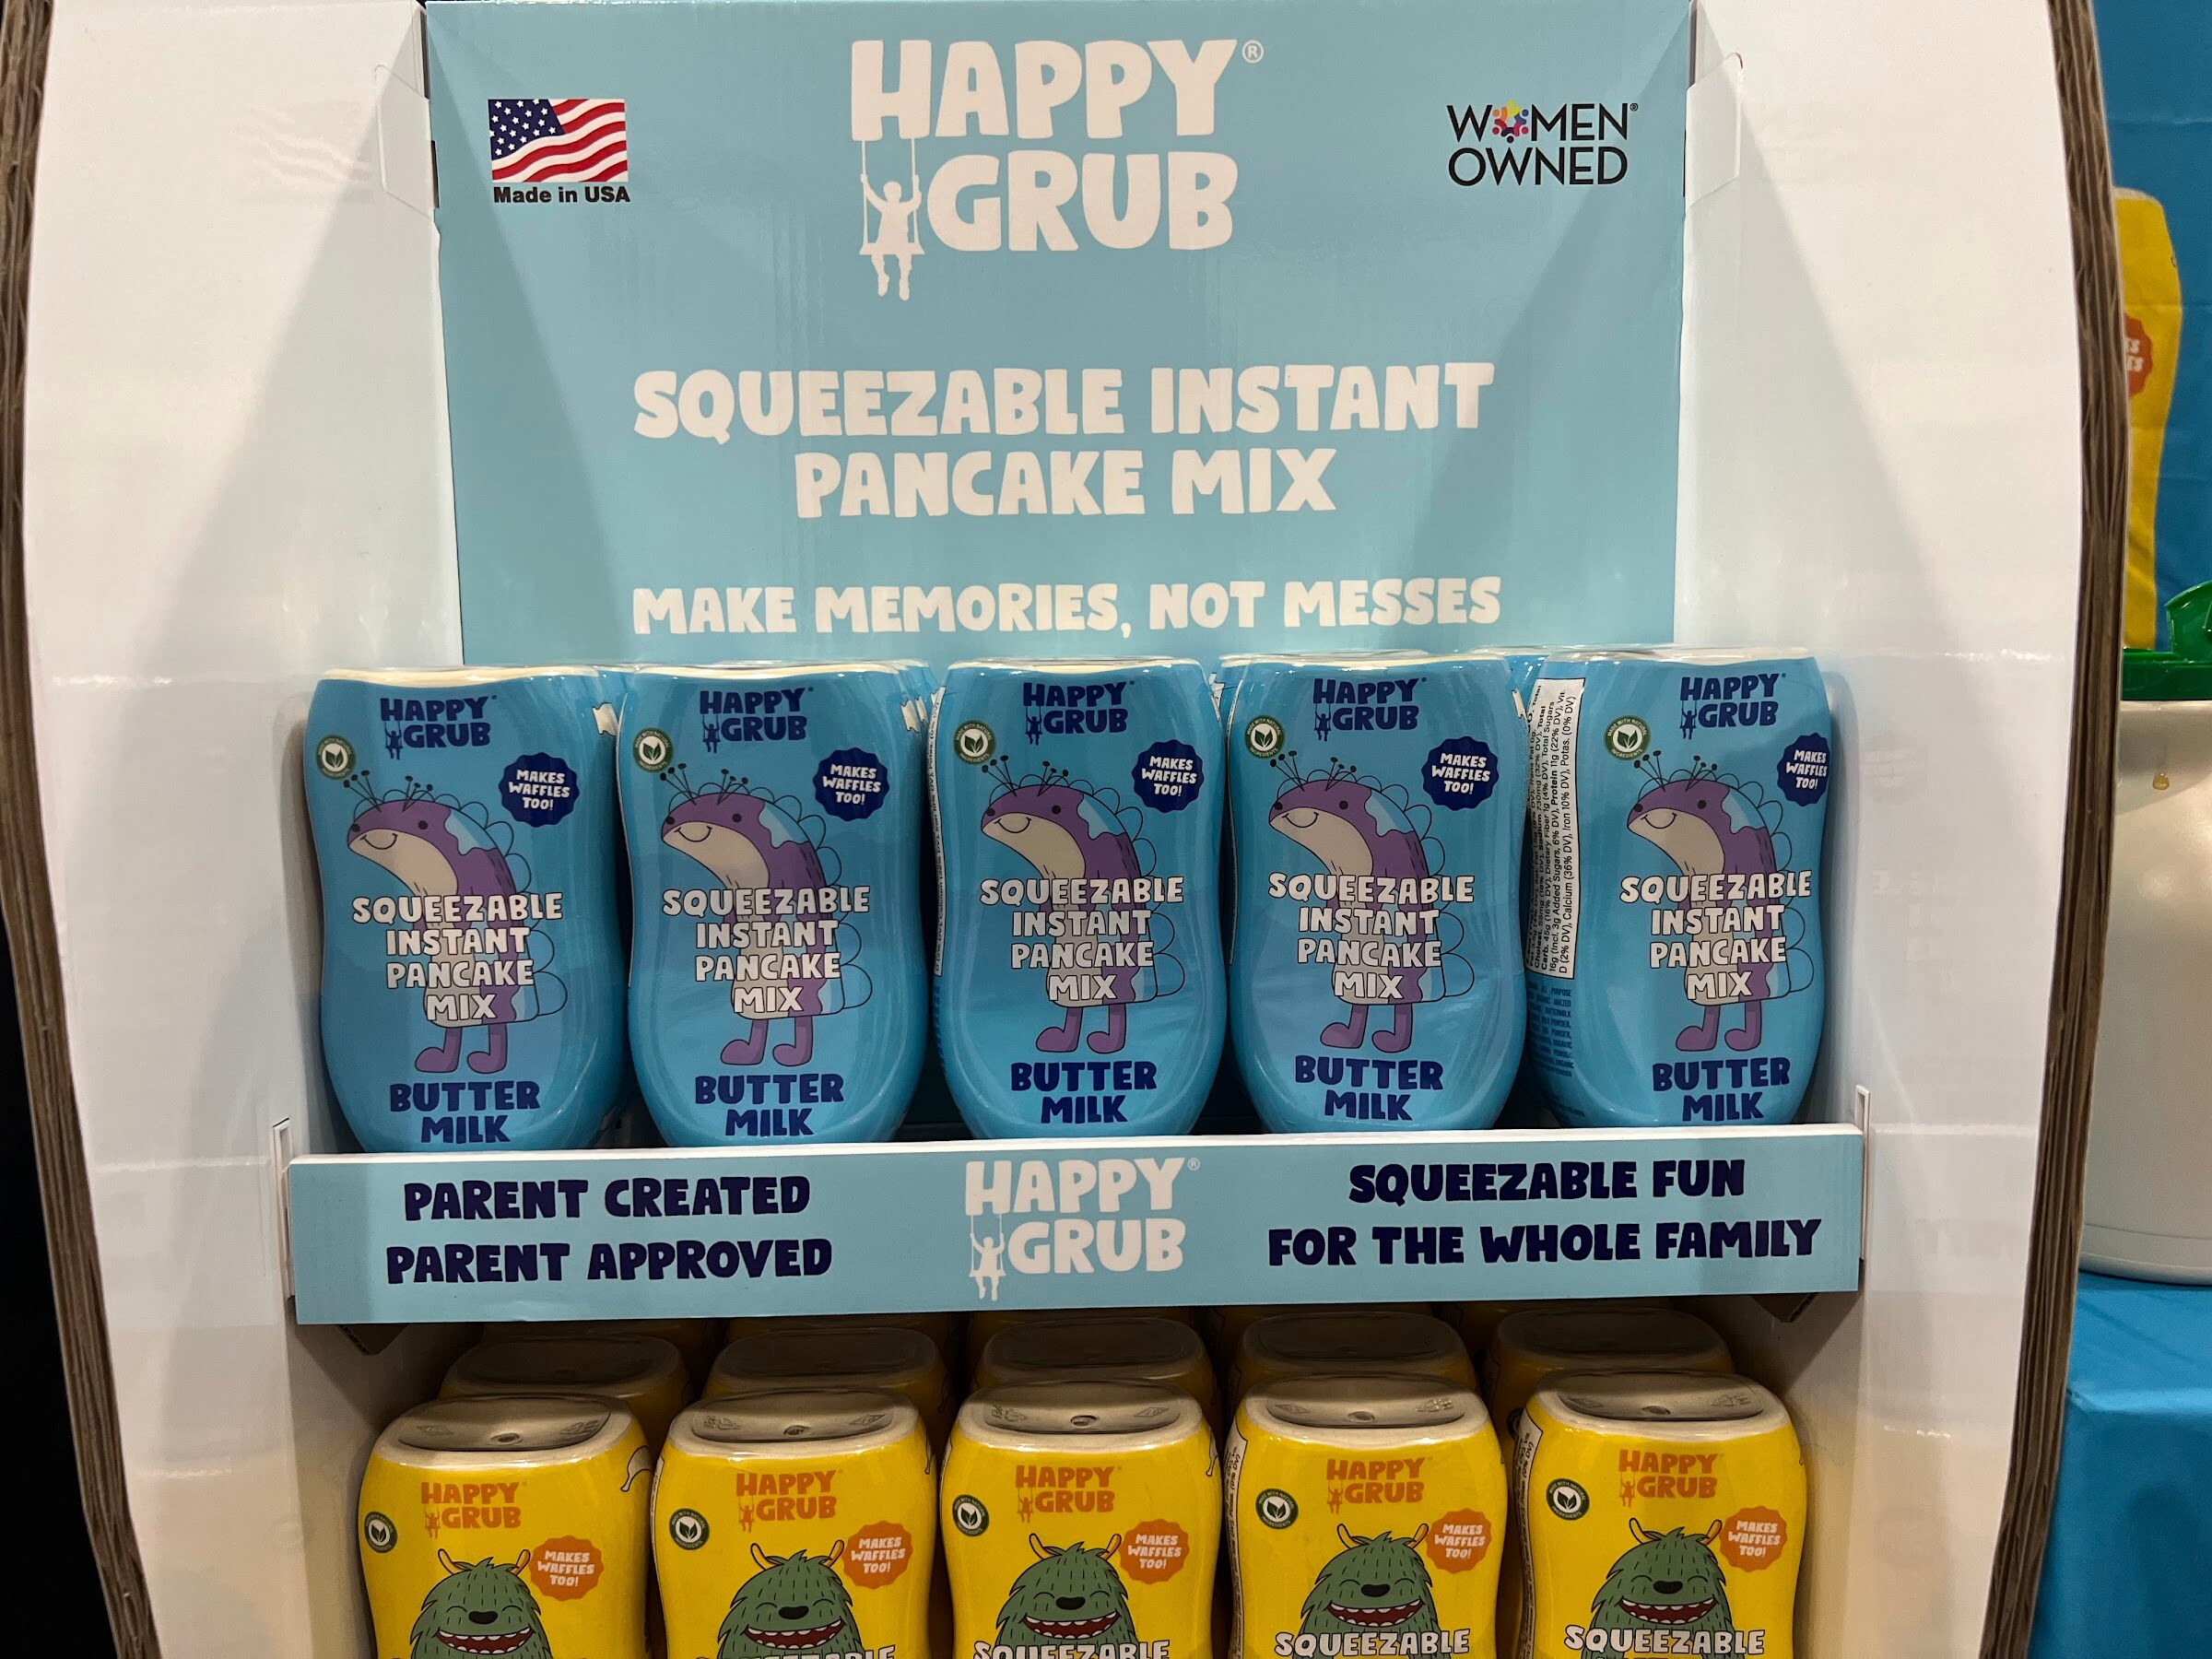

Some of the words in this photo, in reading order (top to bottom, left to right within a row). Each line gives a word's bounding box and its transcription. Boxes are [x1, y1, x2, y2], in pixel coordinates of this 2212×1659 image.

[1448, 146, 1629, 186] OWNED
[494, 186, 551, 204] Made
[559, 186, 578, 204] in
[584, 186, 630, 204] USA
[926, 150, 1238, 251] GRUB
[633, 368, 1124, 444] SQUEEZABLE
[1150, 362, 1495, 434] INSTANT
[794, 449, 1145, 519] PANCAKE
[1171, 448, 1336, 513] MIX
[632, 586, 796, 634] MAKE
[816, 582, 1132, 639] MEMORIES,
[1150, 580, 1265, 629] NOT
[1282, 576, 1502, 628] MESSES
[1022, 681, 1127, 708] HAPPY
[1312, 677, 1419, 705] HAPPY
[1557, 689, 1566, 704] Vit.
[1679, 673, 1780, 701] HAPPY
[380, 695, 489, 722] HAPPY
[700, 687, 806, 715] HAPPY
[1564, 696, 1576, 714] DV)
[1698, 700, 1779, 728] GRUB
[1042, 708, 1128, 735] GRUB
[1332, 705, 1420, 731] GRUB
[1543, 701, 1555, 733] Sugars
[1553, 705, 1564, 725] DV),
[1561, 716, 1572, 735] (0%
[403, 722, 491, 748] GRUB
[721, 715, 807, 742] GRUB
[1550, 727, 1560, 752] (22%
[1541, 735, 1549, 757] Total
[1560, 737, 1570, 767] Potas.
[1794, 749, 1827, 764] MAKES
[830, 763, 877, 780] MAKES
[1148, 755, 1194, 771] MAKES
[1431, 764, 1491, 782] WAFFLES
[1439, 752, 1488, 769] MAKES
[1541, 759, 1549, 780] DV),
[1550, 754, 1559, 768] 11g
[1785, 761, 1828, 778] WAFFLES
[516, 769, 566, 784] MAKES
[822, 775, 881, 794] WAFFLES
[1141, 767, 1197, 784] WAFFLES
[1443, 780, 1475, 794] TOO!
[1549, 771, 1559, 806] Protein
[1560, 769, 1571, 789] DV),
[1795, 776, 1818, 790] TOO!
[508, 781, 571, 798] WAFFLES
[835, 791, 865, 806] TOO!
[1153, 783, 1182, 797] TOO!
[1541, 782, 1549, 801] (4%
[1560, 792, 1571, 810] 10%
[523, 796, 554, 811] TOO!
[1542, 803, 1550, 812] 1g
[1551, 808, 1559, 828] DV),
[1561, 813, 1571, 831] Iron
[1551, 830, 1559, 845] 6%
[1562, 833, 1573, 853] DV),
[1552, 848, 1562, 882] Sugars,
[1563, 855, 1574, 880] (36%
[980, 877, 1184, 907] SQUEEZABLE
[1268, 872, 1476, 905] SQUEEZABLE
[1551, 885, 1560, 915] Added
[1619, 870, 1813, 905] SQUEEZABLE
[352, 891, 563, 924] SQUEEZABLE
[662, 886, 871, 918] SQUEEZABLE
[1562, 882, 1573, 920] Calcium
[1012, 909, 1152, 937] INSTANT
[1298, 906, 1441, 936] INSTANT
[1551, 918, 1561, 930] 3g
[1650, 903, 1786, 935] INSTANT
[385, 926, 532, 957] INSTANT
[696, 919, 840, 950] INSTANT
[1543, 924, 1551, 942] 45g
[1560, 923, 1573, 943] DV),
[1011, 941, 1154, 969] PANCAKE
[1297, 937, 1443, 969] PANCAKE
[1541, 944, 1549, 971] Carb.
[1549, 957, 1559, 972] 16g
[1559, 945, 1570, 963] (2%
[1649, 935, 1787, 969] PANCAKE
[386, 959, 535, 989] PANCAKE
[695, 952, 841, 982] PANCAKE
[1048, 974, 1117, 1002] MIX
[1333, 971, 1405, 1000] MIX
[1687, 971, 1753, 1002] MIX
[426, 993, 497, 1022] MIX
[734, 986, 803, 1014] MIX
[1010, 1060, 1158, 1092] BUTTER
[1294, 1054, 1444, 1090] BUTTER
[1652, 1056, 1792, 1092] BUTTER
[390, 1080, 541, 1112] BUTTER
[695, 1073, 844, 1105] BUTTER
[1041, 1094, 1128, 1124] MILK
[1324, 1089, 1413, 1122] MILK
[1682, 1091, 1764, 1123] MILK
[420, 1114, 511, 1144] MILK
[724, 1108, 815, 1137] MILK
[1348, 1161, 1637, 1207] SQUEEZABLE
[1652, 1159, 1746, 1197] FUN
[404, 1180, 587, 1223] PARENT
[605, 1175, 810, 1218] CREATED
[1008, 1218, 1188, 1275] GRUB
[1268, 1226, 1357, 1266] FOR
[1372, 1226, 1464, 1264] THE
[1480, 1224, 1641, 1263] WHOLE
[1655, 1218, 1821, 1258] FAMILY
[386, 1242, 571, 1285] PARENT
[587, 1238, 832, 1280] APPROVED
[1326, 1456, 1426, 1480] HAPPY
[1618, 1448, 1719, 1475] HAPPY
[736, 1470, 837, 1497] HAPPY
[1015, 1465, 1115, 1488] HAPPY
[1636, 1476, 1718, 1499] GRUB
[420, 1481, 521, 1505] HAPPY
[1034, 1490, 1115, 1513] GRUB
[1344, 1480, 1426, 1505] GRUB
[441, 1506, 522, 1529] GRUB
[756, 1495, 838, 1522] GRUB
[1135, 1533, 1179, 1547] MAKES
[1441, 1523, 1484, 1535] MAKES
[1727, 1530, 1782, 1546] WAFFLES
[1735, 1520, 1778, 1534] MAKES
[858, 1535, 902, 1549] MAKES
[1127, 1544, 1182, 1559] WAFFLES
[1433, 1534, 1487, 1547] WAFFLES
[1444, 1547, 1472, 1559] TOO!
[1738, 1544, 1767, 1558] TOO!
[545, 1550, 590, 1563] MAKES
[851, 1547, 906, 1561] WAFFLES
[1139, 1557, 1167, 1570] TOO!
[536, 1560, 595, 1576] WAFFLES
[549, 1574, 579, 1587] TOO!
[863, 1561, 891, 1574] TOO!
[1274, 1629, 1471, 1658] SQUEEZABLE
[1564, 1624, 1766, 1655] SQUEEZABLE
